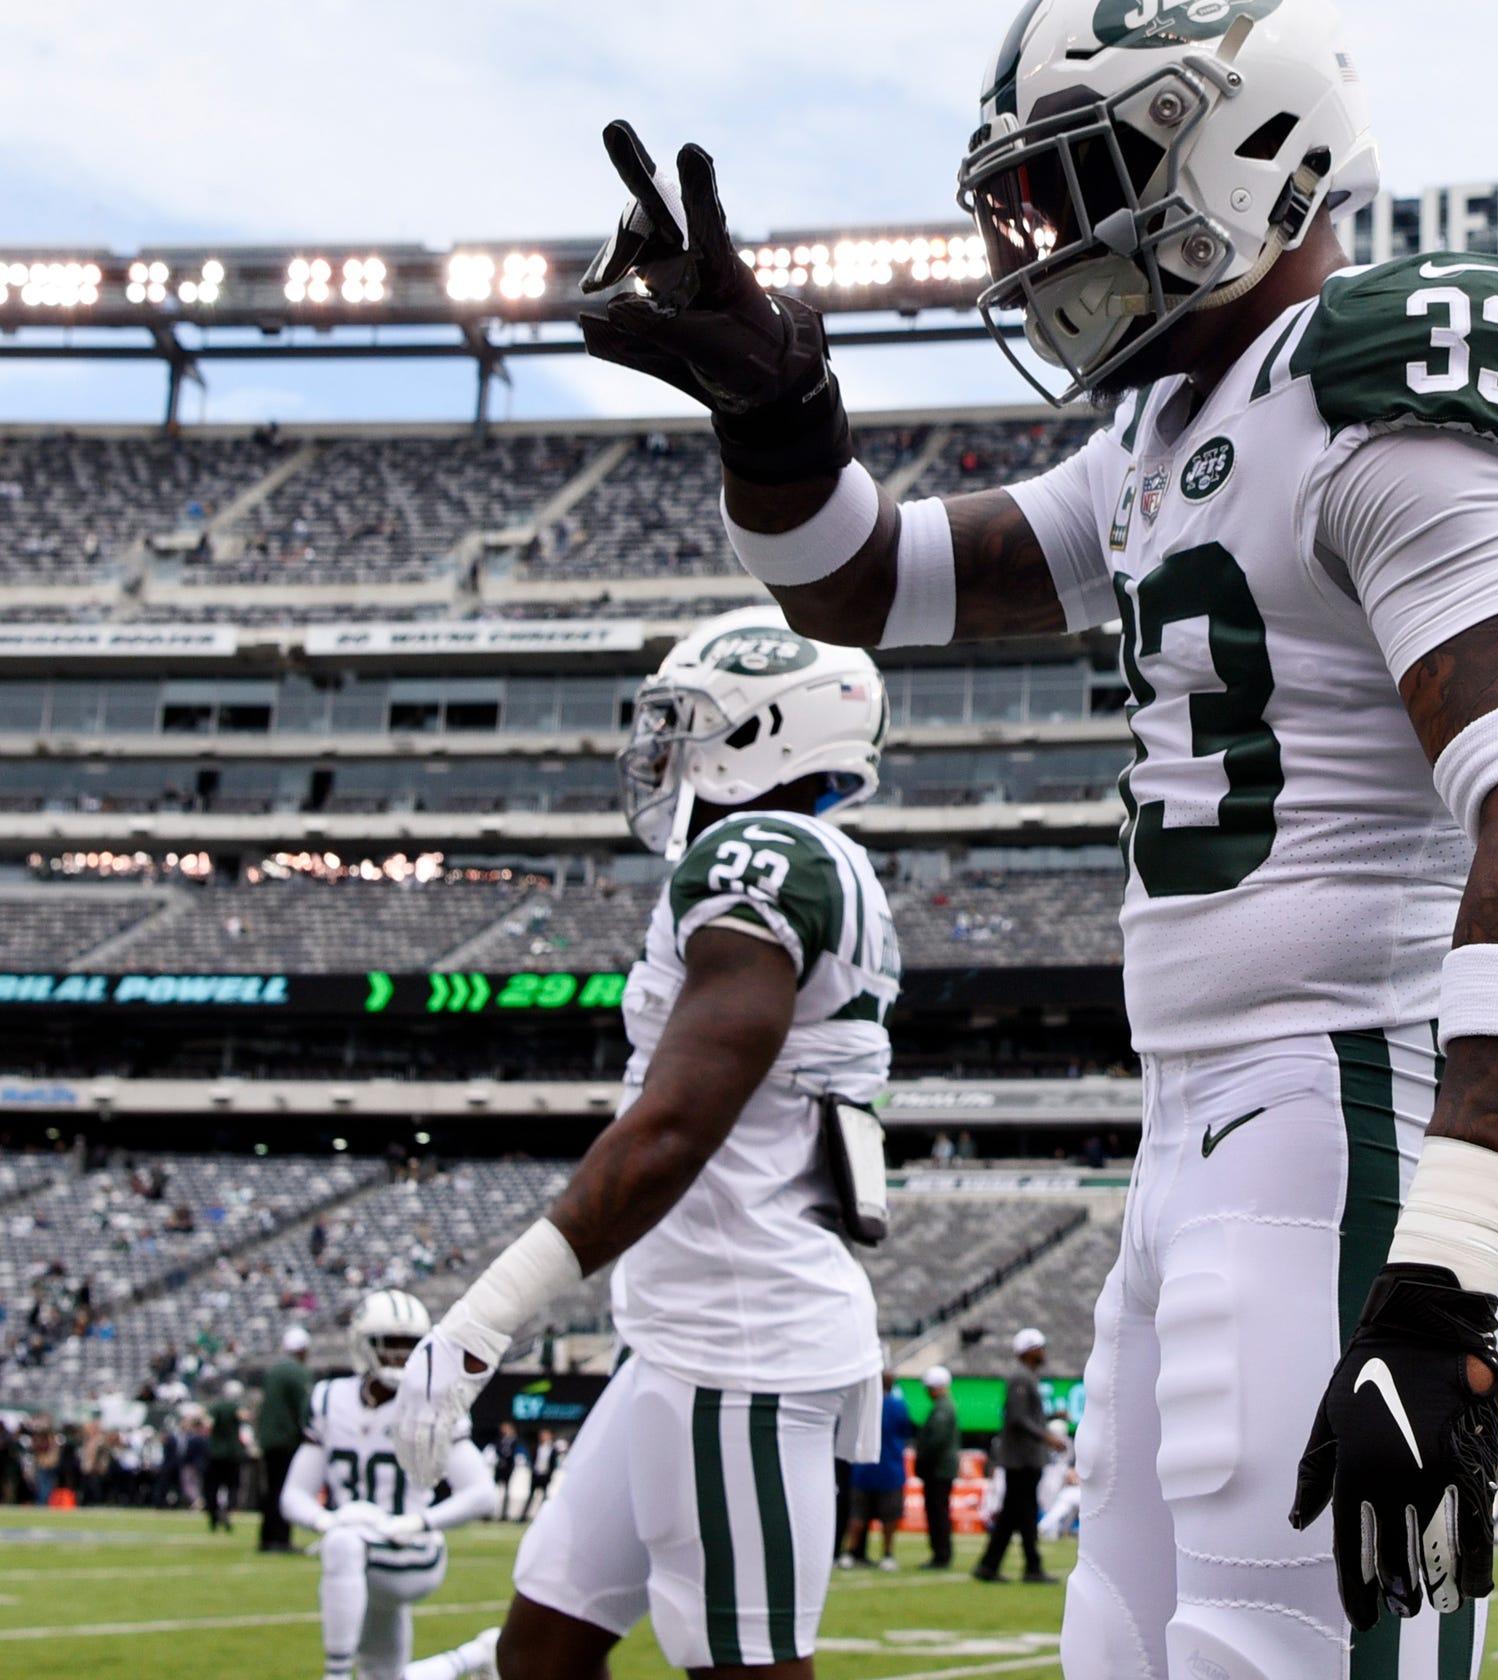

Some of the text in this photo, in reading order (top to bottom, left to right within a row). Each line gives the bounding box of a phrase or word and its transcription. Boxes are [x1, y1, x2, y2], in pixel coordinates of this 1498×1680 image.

[1185, 454, 1227, 483] JETS
[708, 840, 790, 904] 23
[113, 975, 288, 1003] POWELL
[496, 972, 578, 1008] 29
[327, 1449, 406, 1515] 30
